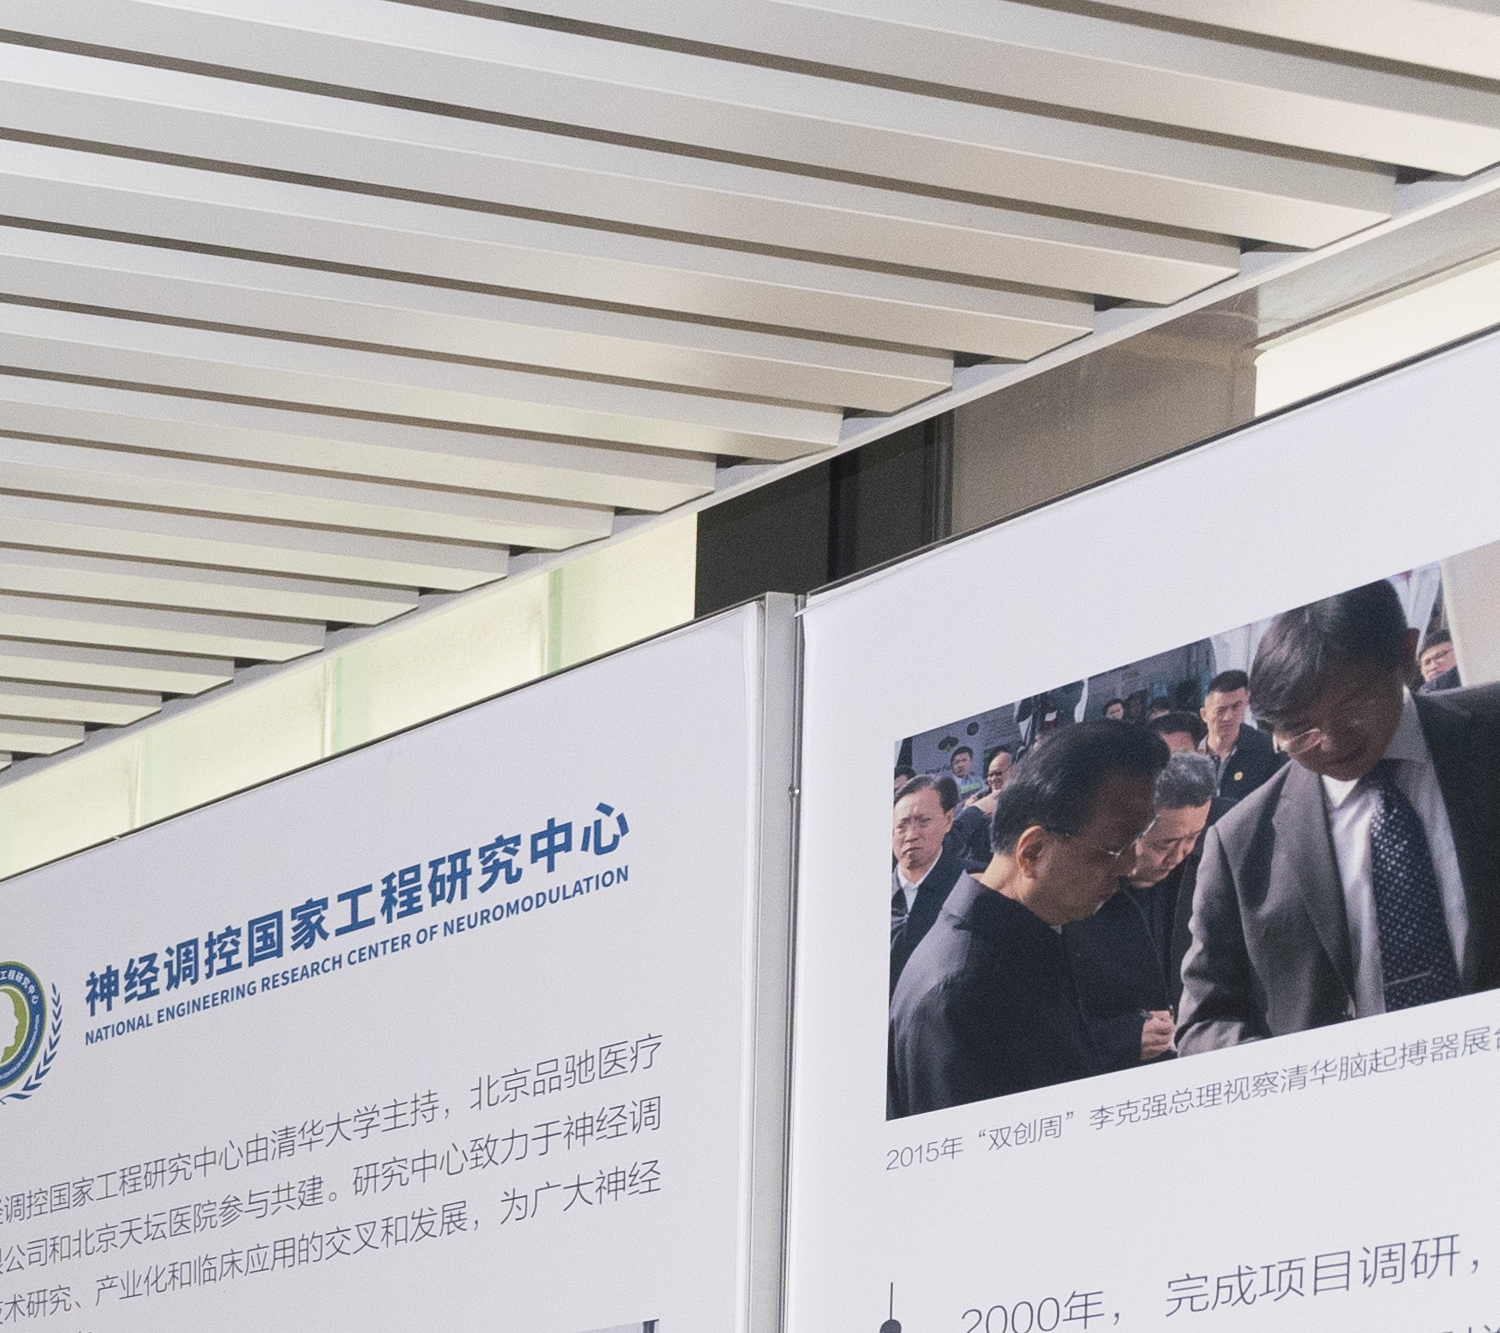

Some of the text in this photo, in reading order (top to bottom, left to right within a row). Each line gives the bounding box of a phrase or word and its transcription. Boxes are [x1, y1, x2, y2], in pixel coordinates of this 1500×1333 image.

[84, 803, 631, 1018] 神经调控国家工程研究中心
[84, 864, 630, 1047] NATIONAL ENGINEERING RESEARCH CENTER OF NEUROMODULATION
[885, 1025, 1500, 1172] 2015年“双创周”李克强总理视察清华脑起搏器展
